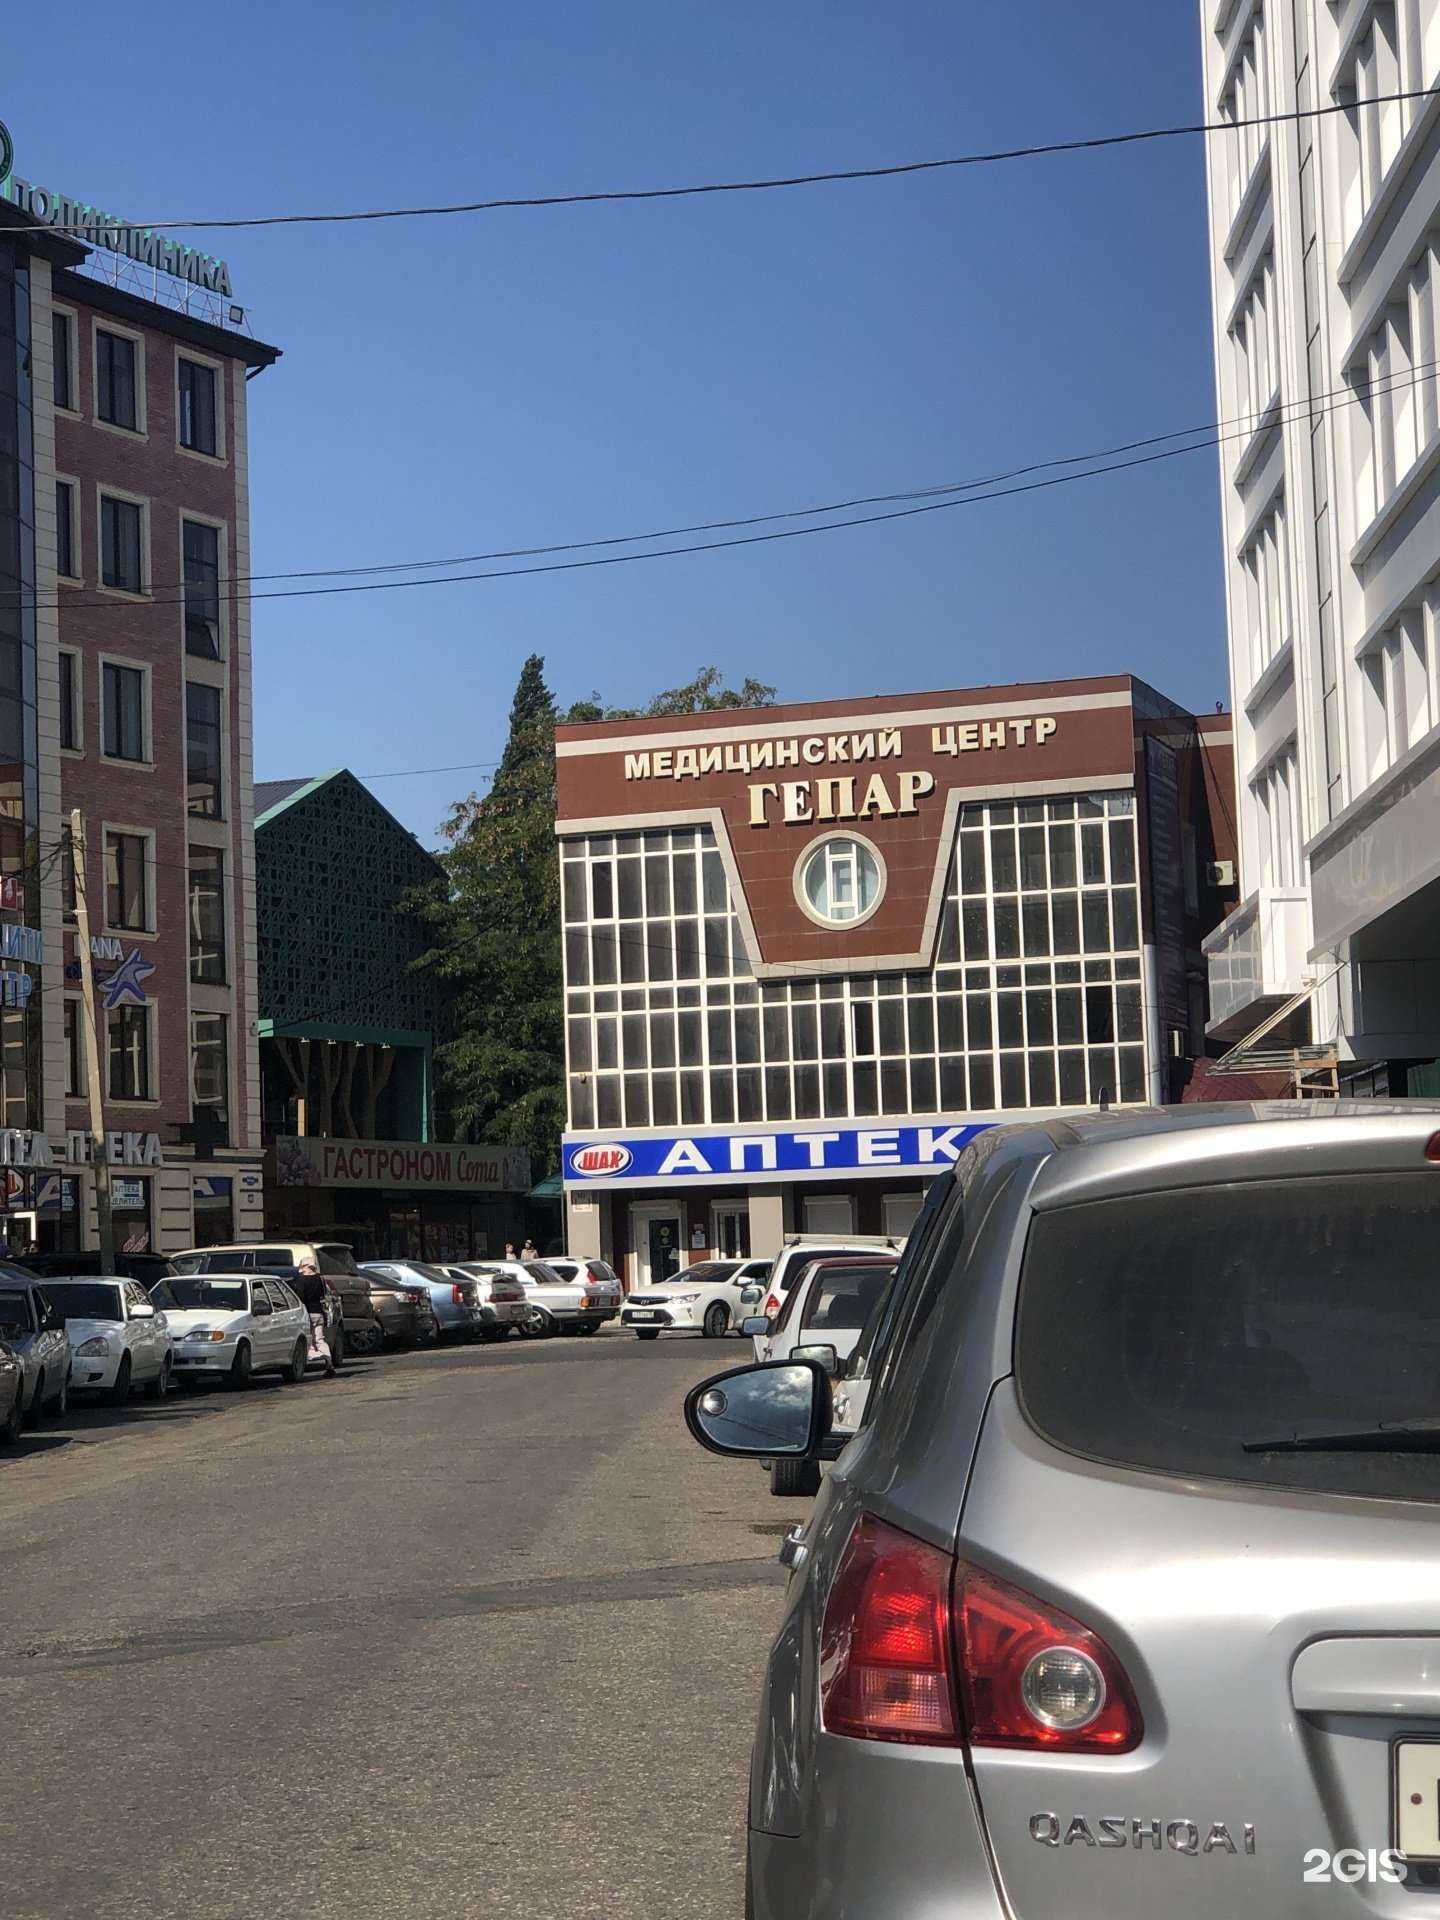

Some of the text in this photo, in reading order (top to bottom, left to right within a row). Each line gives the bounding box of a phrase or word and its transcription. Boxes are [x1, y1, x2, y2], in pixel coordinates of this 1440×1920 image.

[624, 717, 1058, 780] МЕДИЦИНСКИЙ ЦЕНТР
[747, 770, 936, 826] ГЕПАР
[322, 1146, 451, 1182] ГАСТРОНОМ
[1029, 1811, 1257, 1856] QASHQAI
